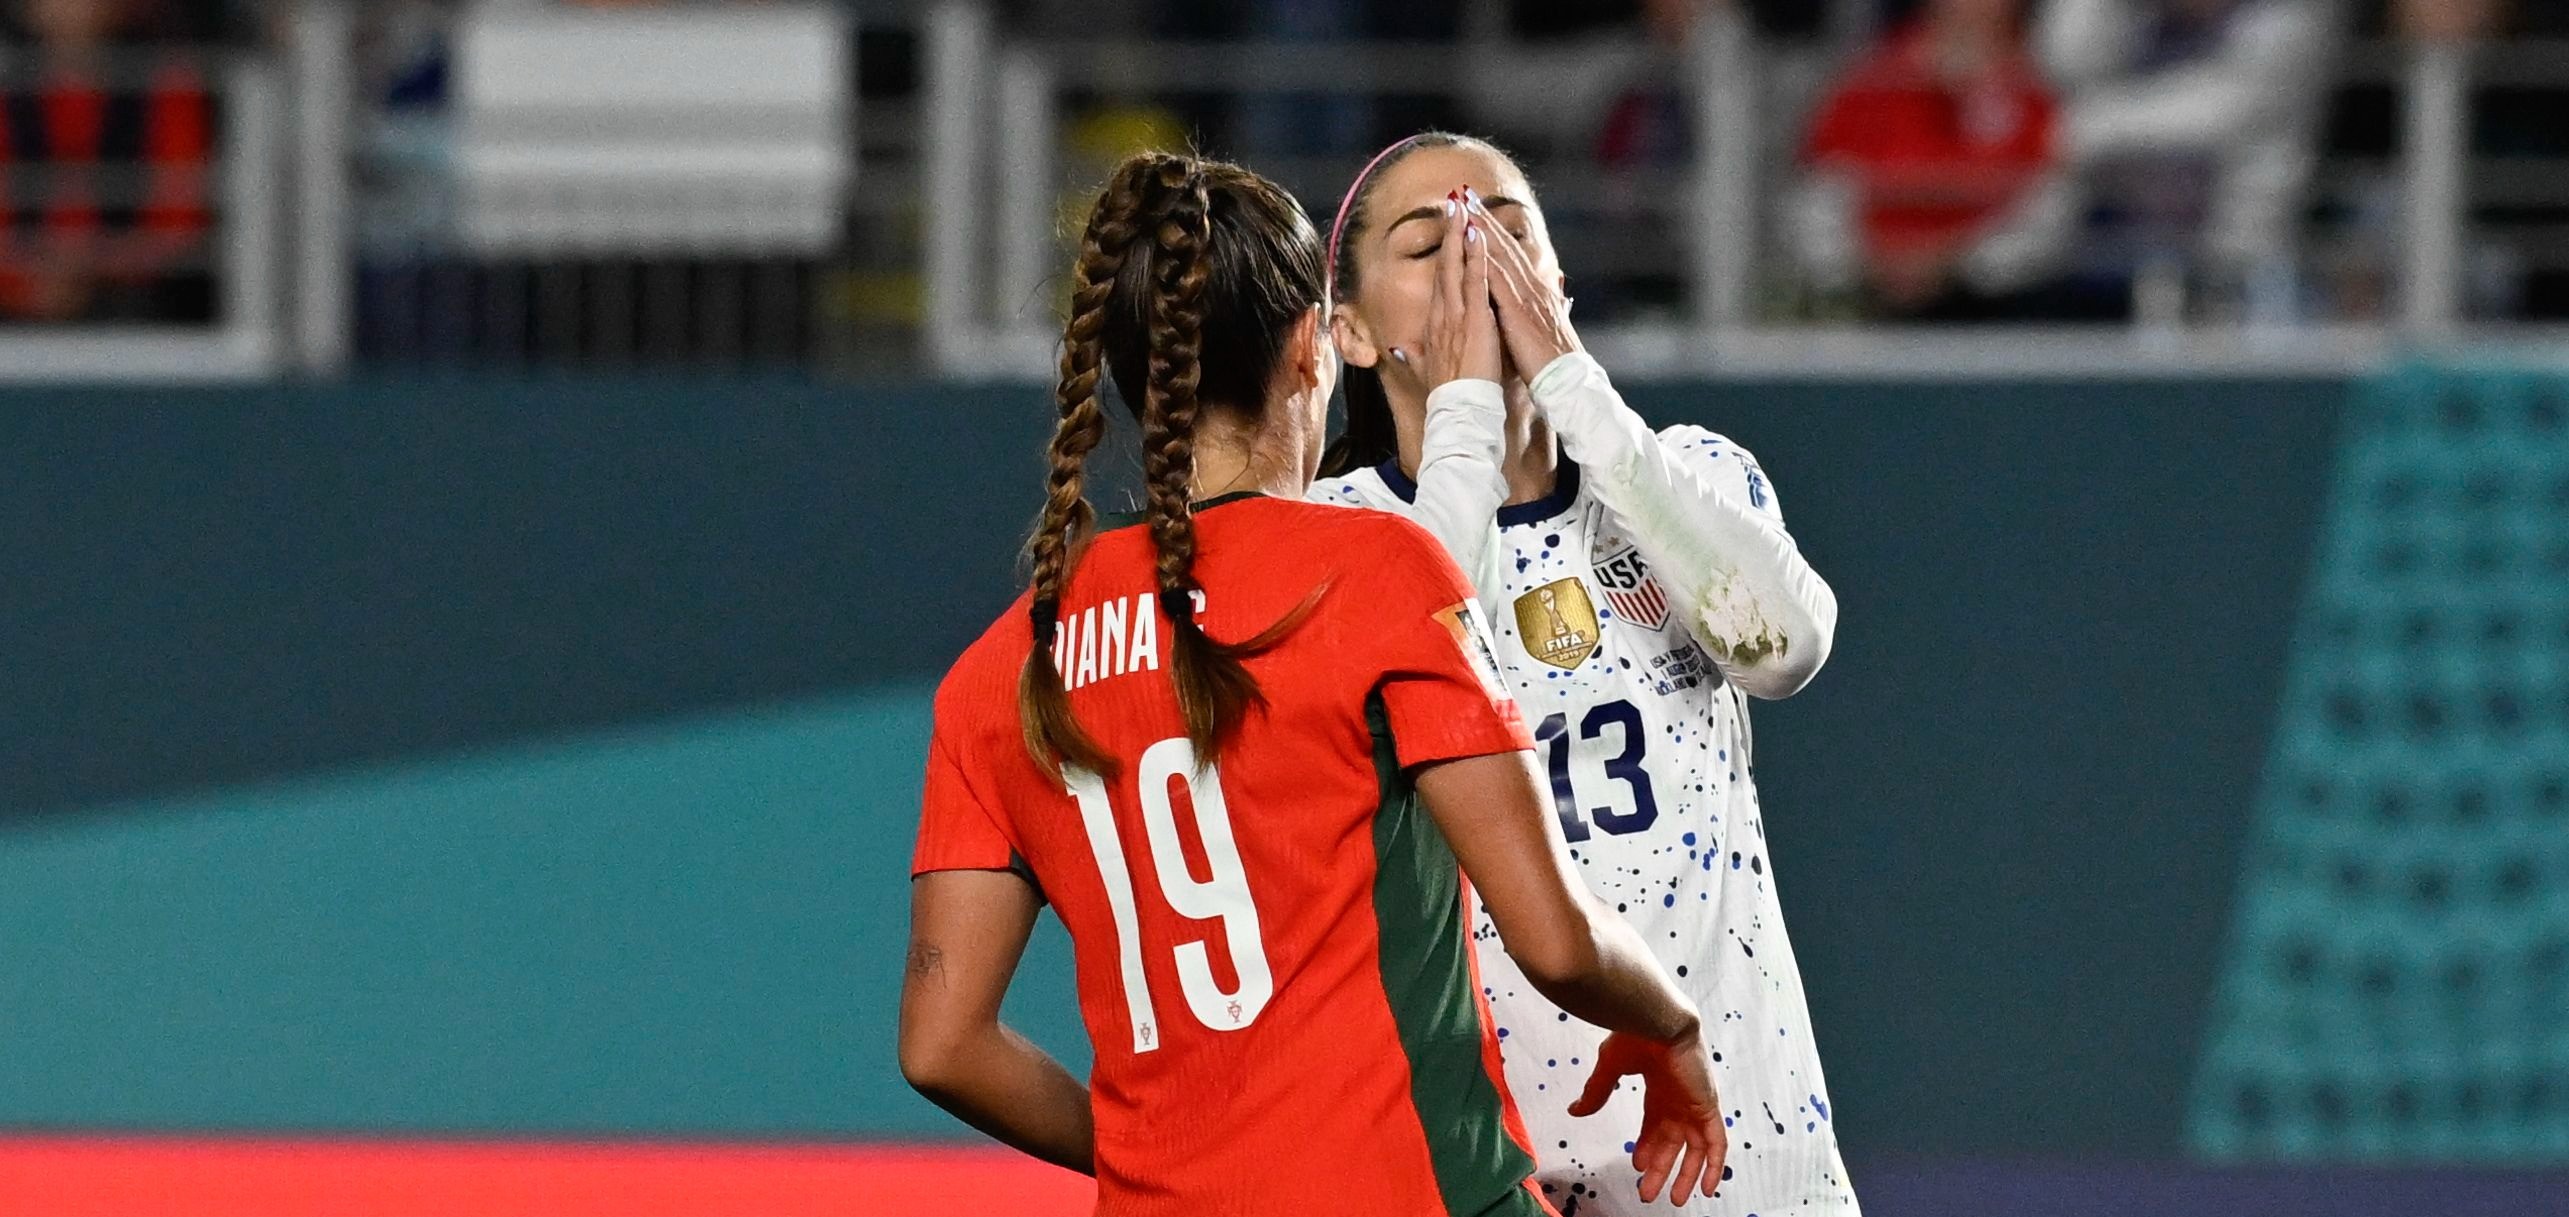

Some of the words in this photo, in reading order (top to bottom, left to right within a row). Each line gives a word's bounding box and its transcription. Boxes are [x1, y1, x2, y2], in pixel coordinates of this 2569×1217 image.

[1546, 633, 1583, 652] FIFA
[1535, 699, 1658, 843] 13
[1059, 737, 1273, 1054] 19
